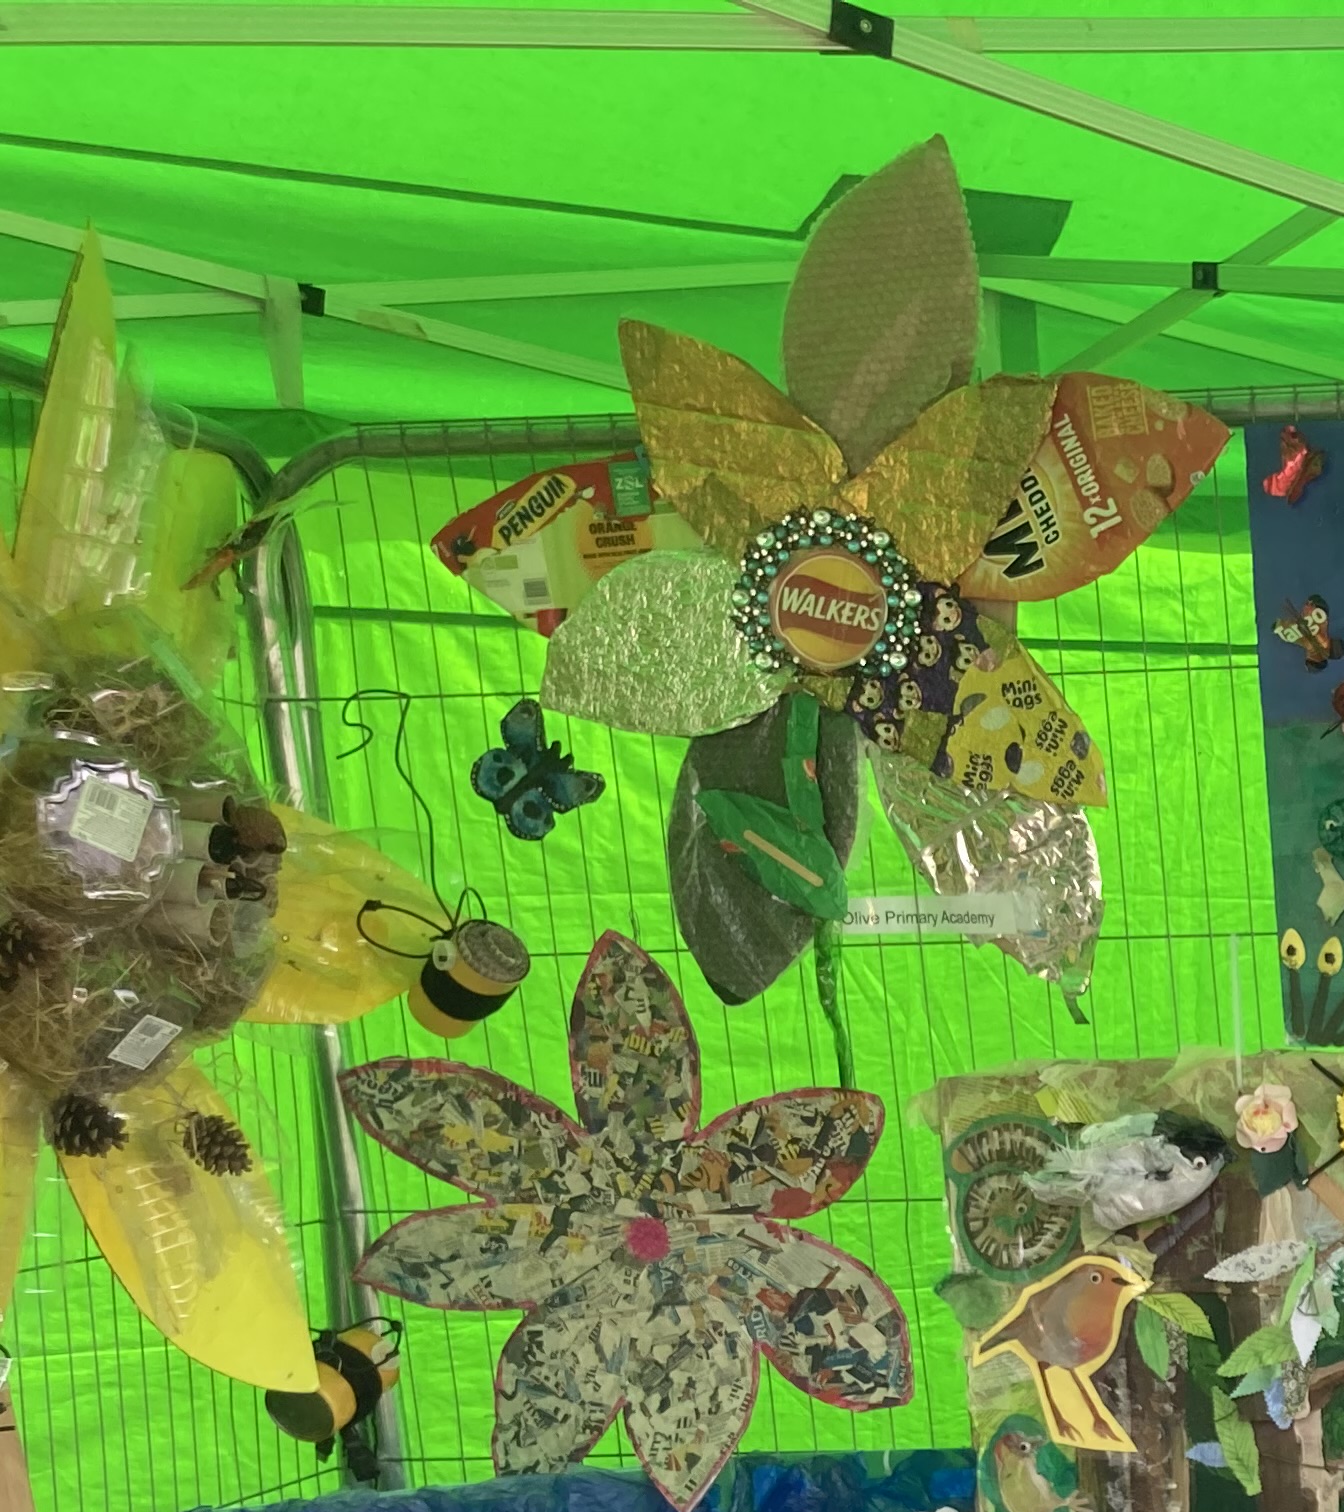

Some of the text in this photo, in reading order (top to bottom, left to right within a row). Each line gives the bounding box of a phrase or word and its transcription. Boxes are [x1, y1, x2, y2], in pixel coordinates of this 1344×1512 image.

[1019, 465, 1061, 546] CHEDD
[595, 533, 636, 549] CRUSH
[781, 585, 883, 632] WALKERS
[1001, 677, 1038, 698] Mini
[1034, 711, 1058, 751] eggs
[1044, 718, 1069, 758] Mini
[1050, 759, 1077, 797] eggs
[1060, 769, 1086, 801] Mini
[841, 910, 996, 928] Olive Primary Academy
